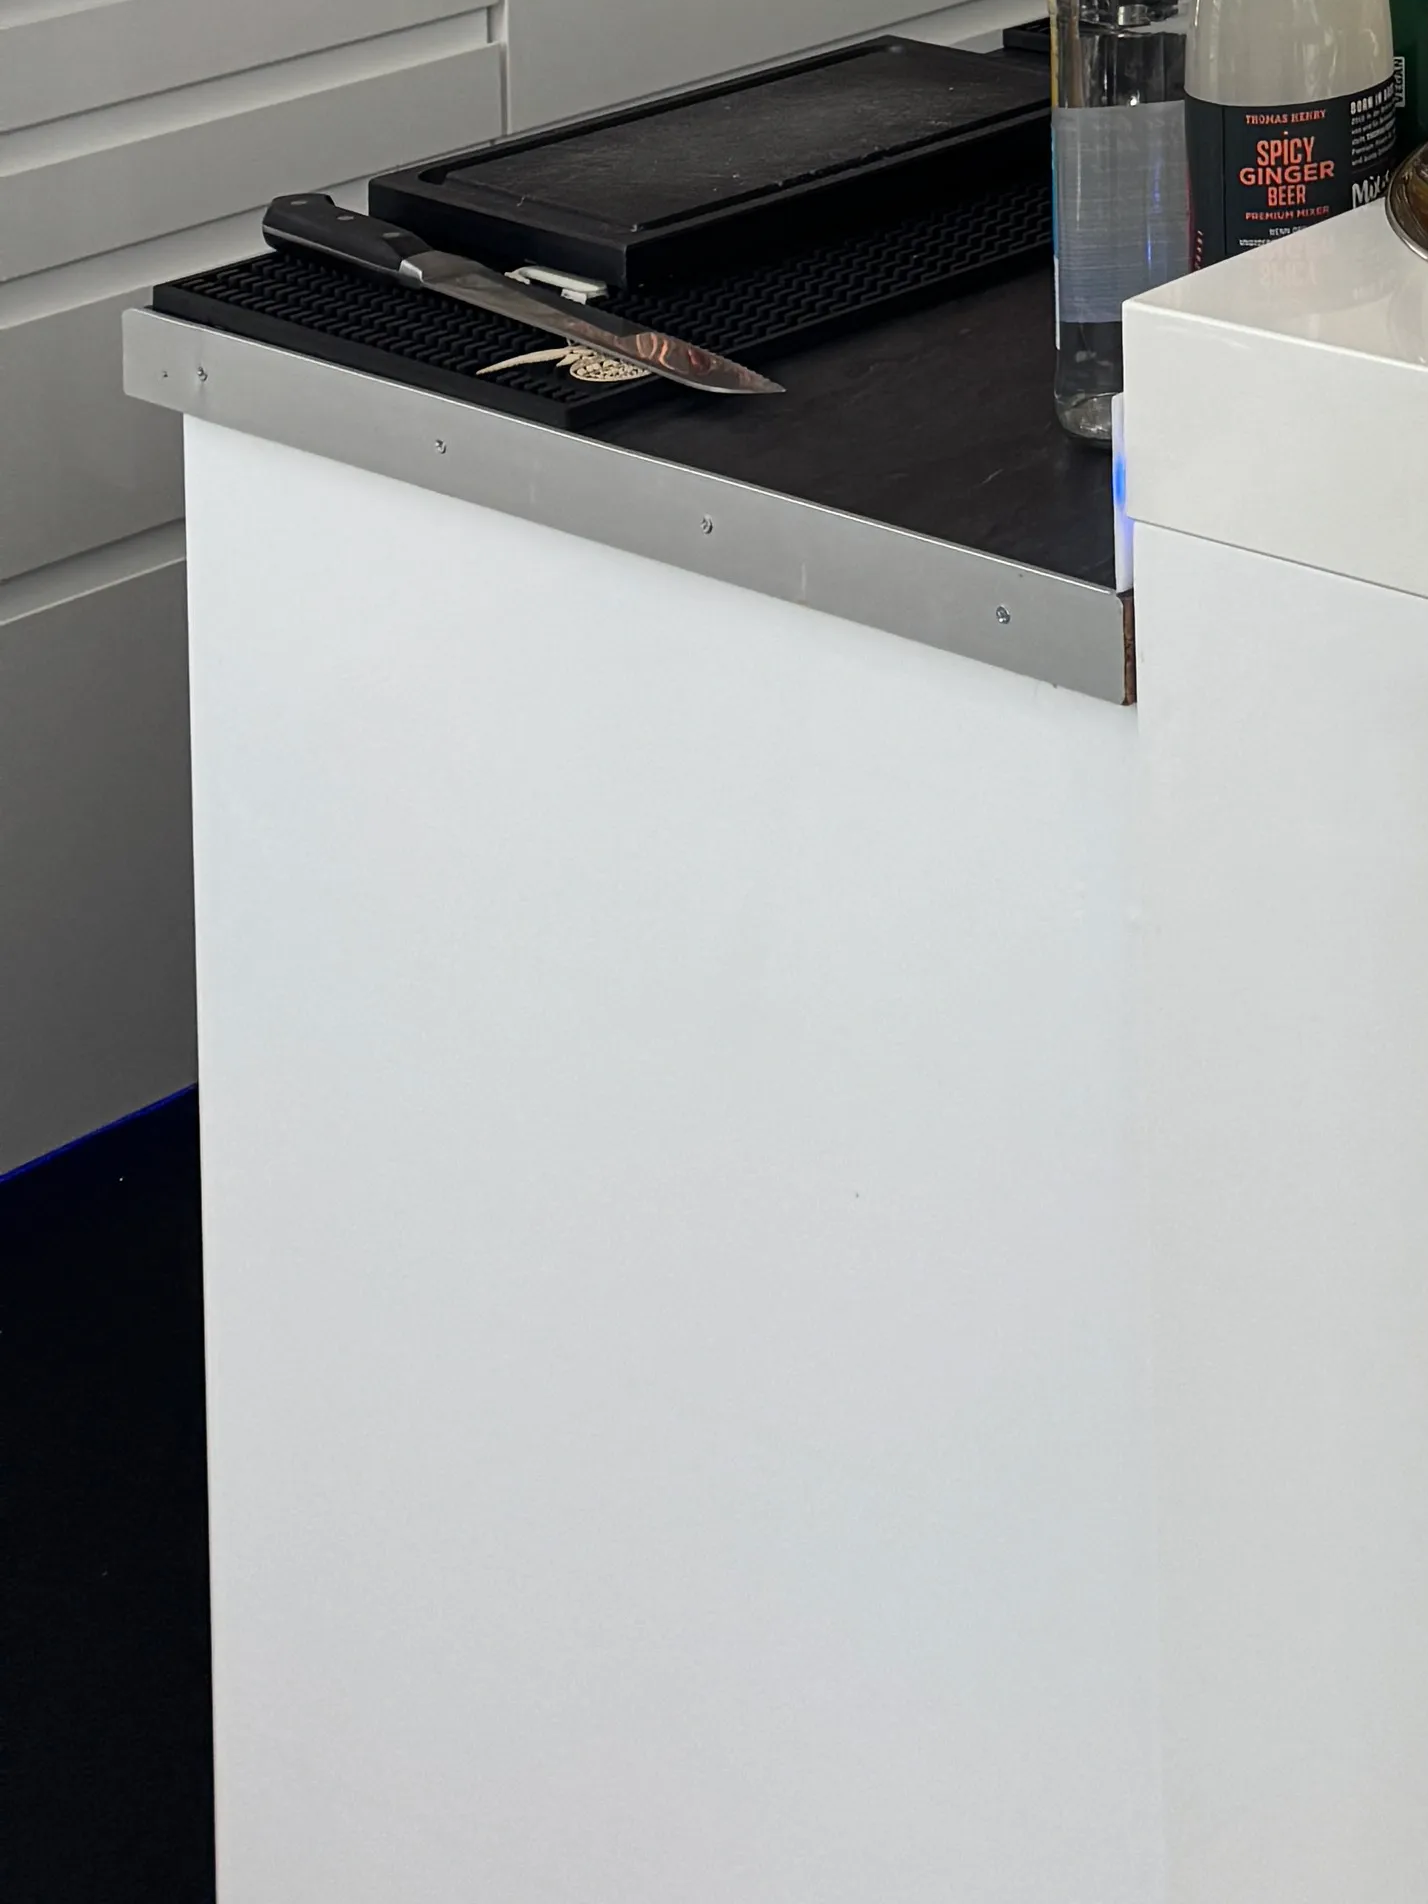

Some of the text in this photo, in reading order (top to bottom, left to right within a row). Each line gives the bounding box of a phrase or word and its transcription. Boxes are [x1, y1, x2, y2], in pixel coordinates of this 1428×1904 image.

[1350, 96, 1373, 115] BORN
[1245, 109, 1327, 125] THOMAS HENRY
[1256, 136, 1315, 167] SPICY
[1239, 160, 1335, 186] GINGER
[1267, 184, 1306, 207] BEER
[1245, 205, 1330, 221] PREMIUM MIXER
